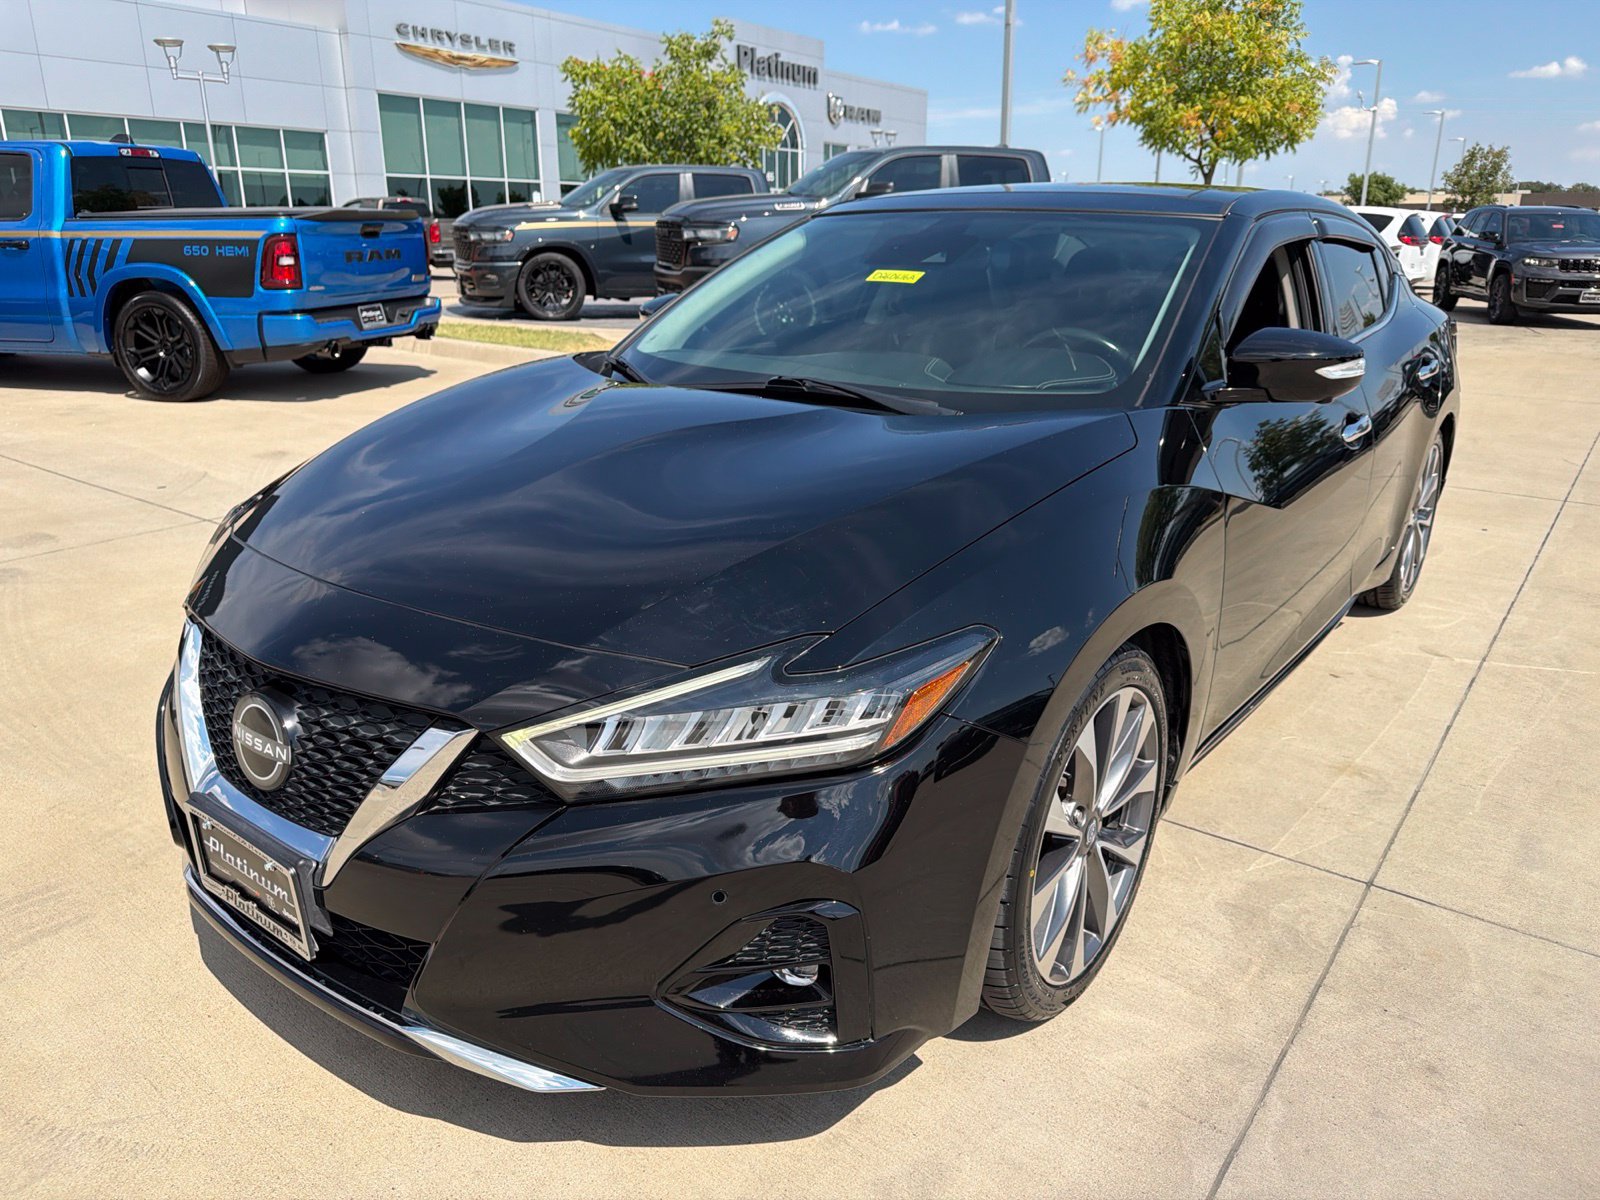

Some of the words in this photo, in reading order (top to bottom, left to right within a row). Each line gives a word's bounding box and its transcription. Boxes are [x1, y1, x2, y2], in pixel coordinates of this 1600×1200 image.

[395, 22, 516, 54] CHRYSLER
[737, 44, 818, 86] Platinum
[183, 245, 209, 256] 650
[215, 246, 249, 257] HEMI
[345, 248, 401, 263] RAM
[234, 722, 288, 761] NISSAN
[204, 836, 296, 908] Platinum
[223, 885, 290, 943] Platinum
